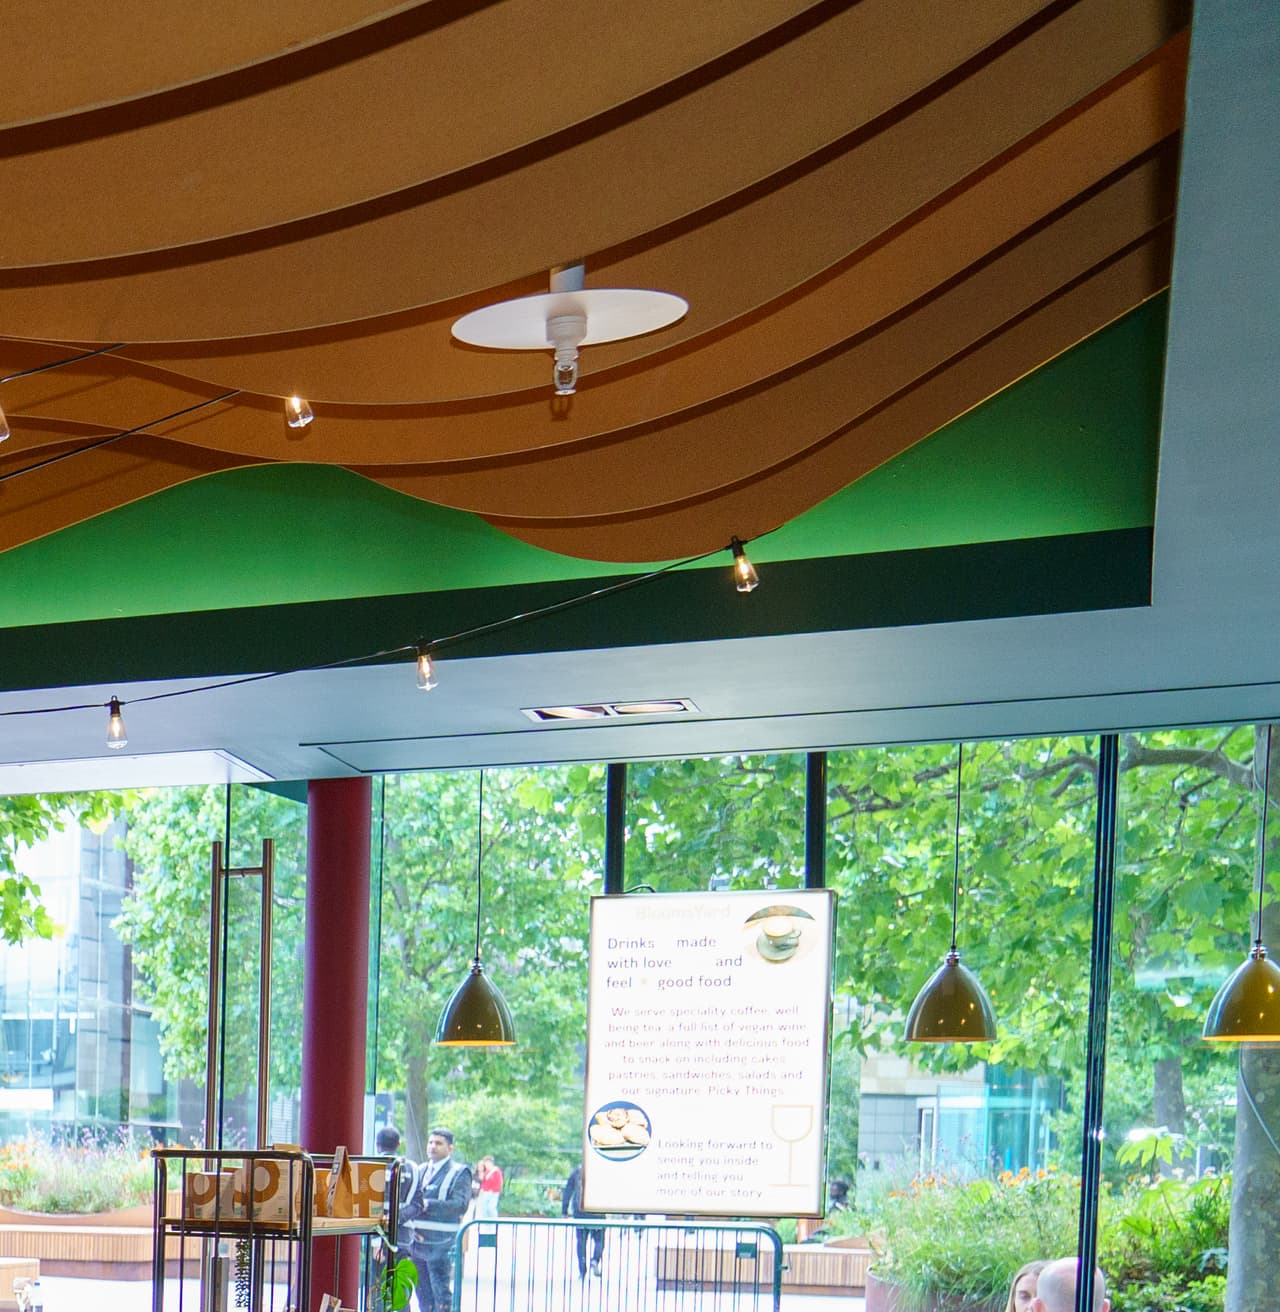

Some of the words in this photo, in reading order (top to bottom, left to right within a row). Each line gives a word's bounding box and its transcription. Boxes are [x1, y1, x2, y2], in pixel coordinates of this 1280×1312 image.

[607, 937, 656, 950] Drinks
[676, 935, 717, 948] made
[607, 956, 639, 969] with
[643, 956, 672, 969] love
[715, 955, 743, 968] and
[606, 976, 633, 989] feel
[657, 975, 694, 991] good
[698, 975, 732, 988] food
[611, 1007, 630, 1017] We
[634, 1008, 666, 1017] serve
[775, 1006, 799, 1016] well
[608, 1023, 640, 1034] being
[677, 1022, 698, 1032] full
[700, 1022, 718, 1032] list
[722, 1022, 736, 1032] of
[739, 1024, 774, 1034] vegan
[604, 1039, 626, 1048] and
[659, 1038, 691, 1049] along
[695, 1038, 721, 1048] with
[724, 1038, 779, 1048] delicious
[782, 1038, 810, 1048] food
[622, 1055, 635, 1064] to
[638, 1055, 671, 1064] snack
[675, 1056, 690, 1064] on
[693, 1054, 748, 1066] including
[780, 1070, 804, 1080] and
[621, 1087, 640, 1096] our
[657, 1139, 704, 1152] Looking
[707, 1139, 757, 1150] forward
[760, 1140, 774, 1150] to
[657, 1156, 695, 1168] seeing
[698, 1157, 720, 1168] you
[723, 1155, 759, 1167] inside
[657, 1171, 678, 1181] and
[722, 1173, 744, 1183] you
[656, 1188, 687, 1197] more
[690, 1186, 703, 1197] of
[705, 1189, 726, 1197] our
